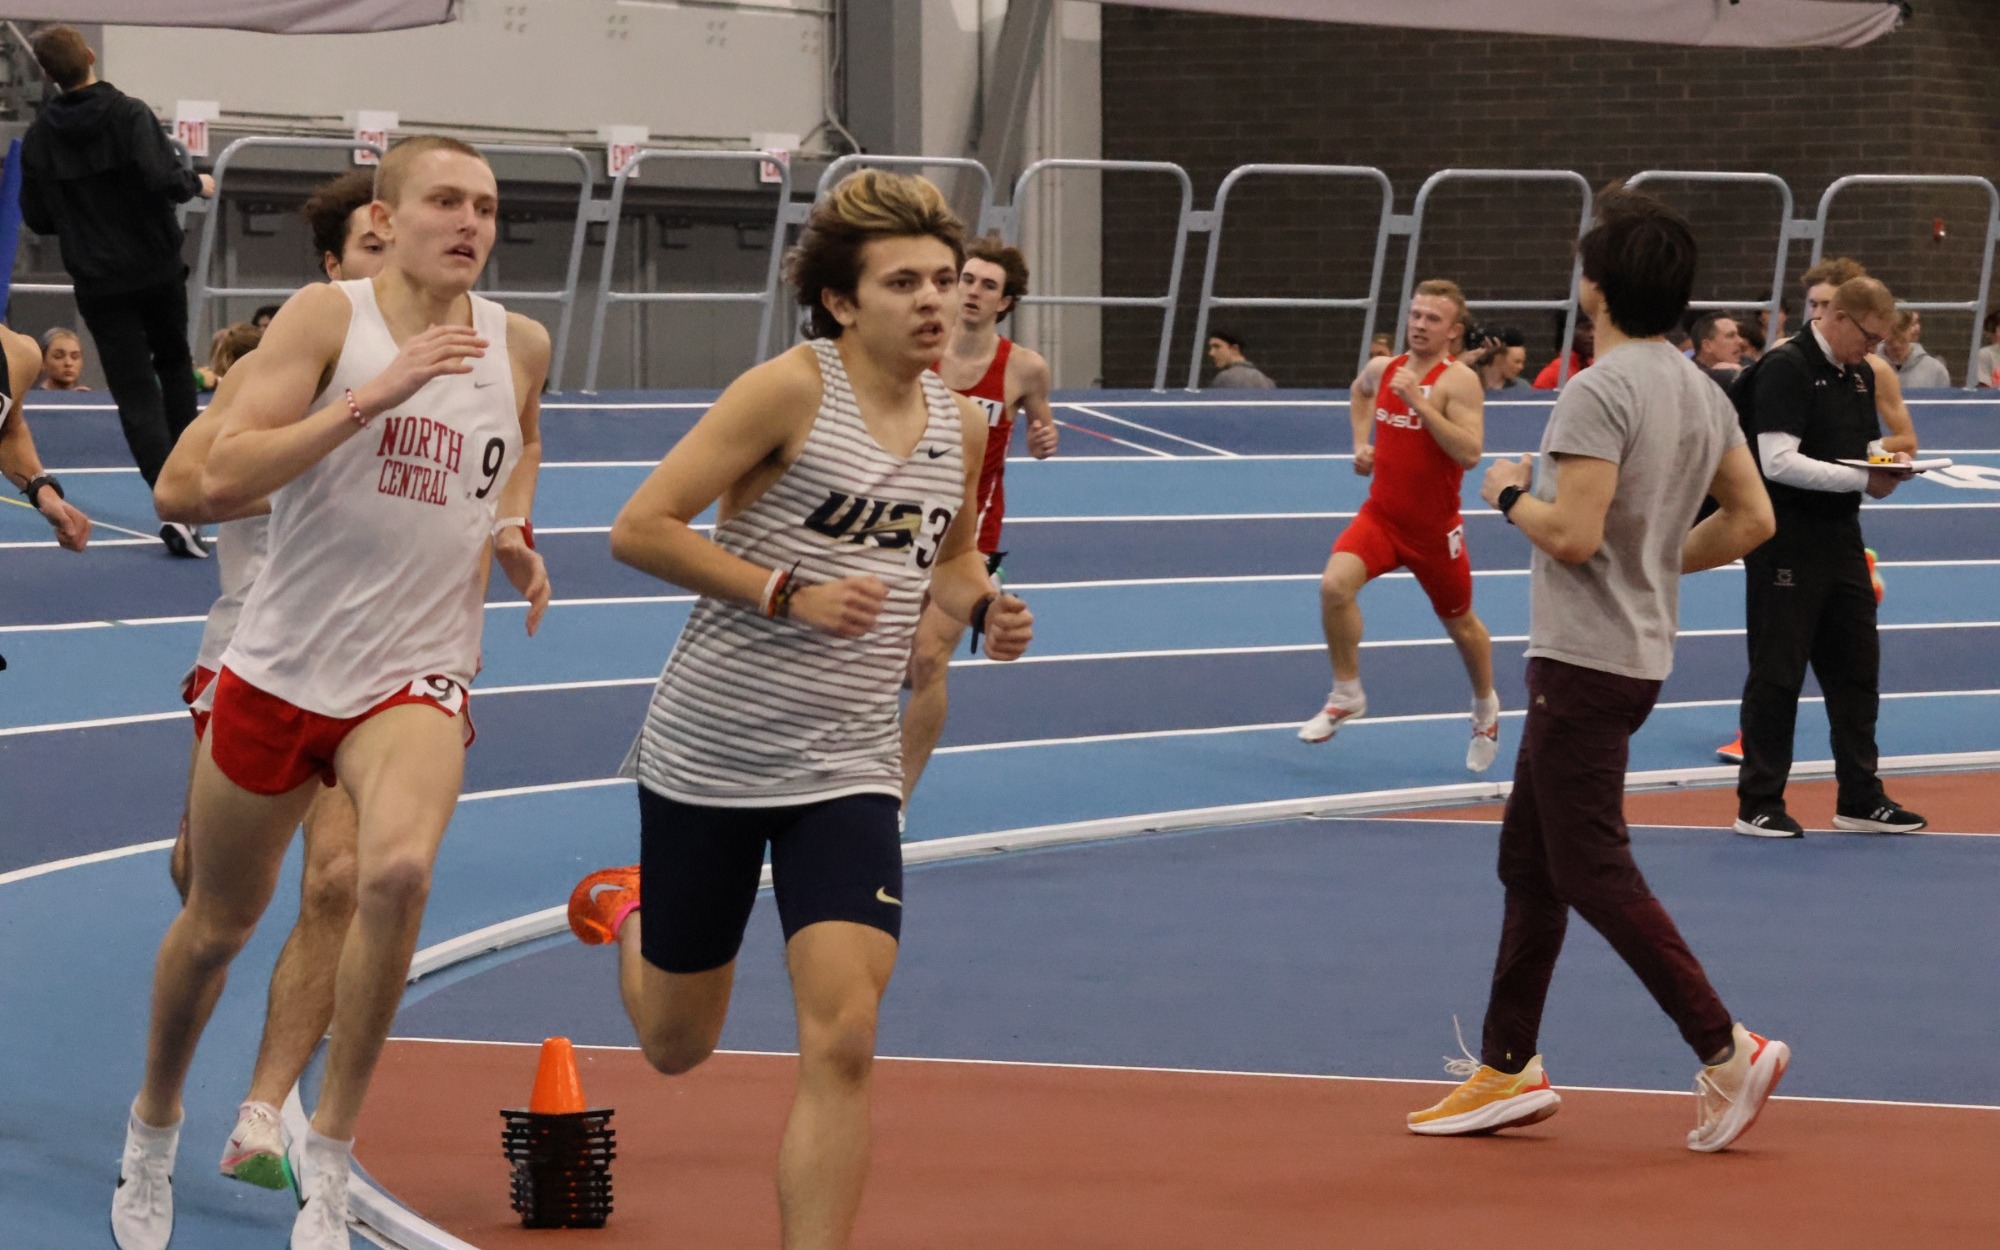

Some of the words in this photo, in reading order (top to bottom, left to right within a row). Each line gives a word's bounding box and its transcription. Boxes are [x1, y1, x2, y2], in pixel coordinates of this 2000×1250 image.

[377, 416, 464, 474] NORTH
[475, 437, 505, 499] 9
[378, 459, 448, 506] CENTRAL
[916, 507, 952, 569] 3
[424, 674, 454, 701] 9
